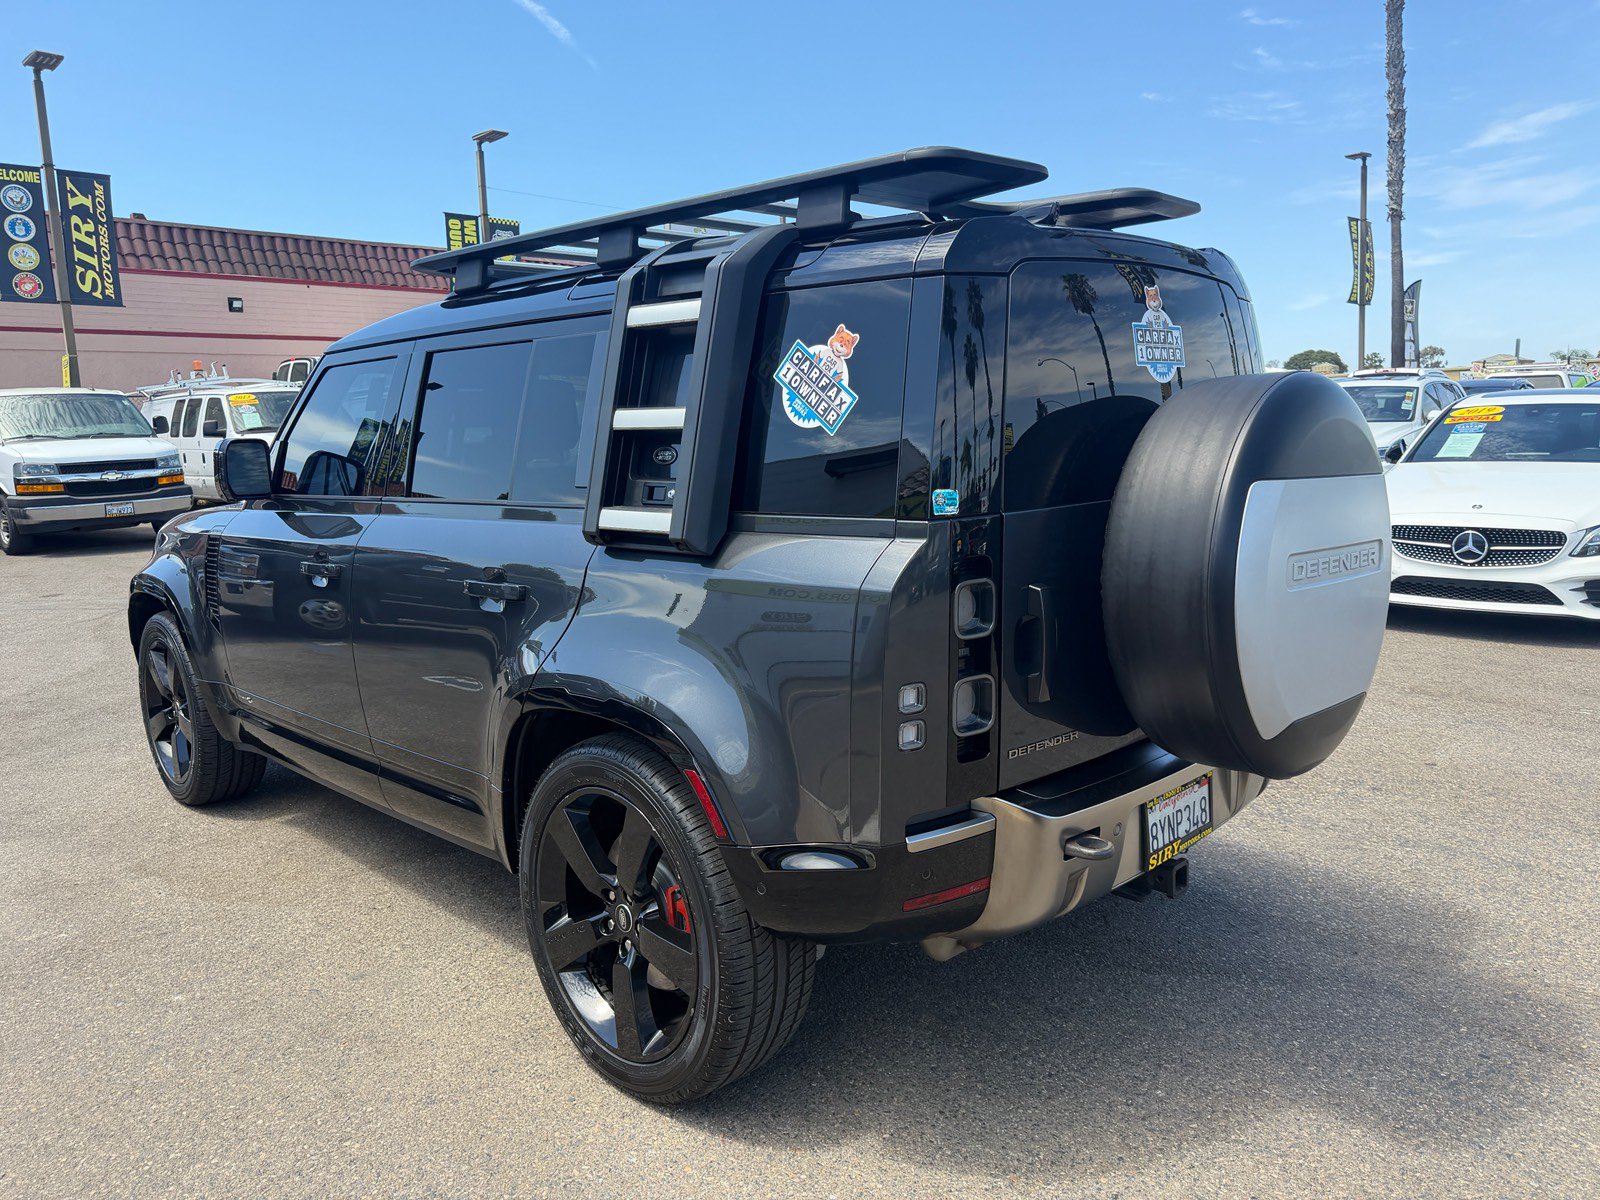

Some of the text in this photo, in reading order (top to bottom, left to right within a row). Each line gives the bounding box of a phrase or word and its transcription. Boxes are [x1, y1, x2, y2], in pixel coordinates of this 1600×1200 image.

[66, 176, 102, 299] SIRY
[94, 180, 115, 300] MOTORS.COM
[463, 220, 478, 245] WE
[1137, 330, 1181, 345] CARFAX
[1139, 347, 1182, 360] 1 OWNER
[782, 367, 791, 379] 1
[790, 376, 838, 425] OWNER
[791, 351, 848, 412] CARFAX
[1449, 415, 1498, 423] SPECIAL
[1292, 547, 1376, 581] DEFENDER
[1008, 730, 1080, 760] DEFENDER
[1150, 796, 1208, 853] 8YNP348
[1148, 839, 1182, 871] SIRY
